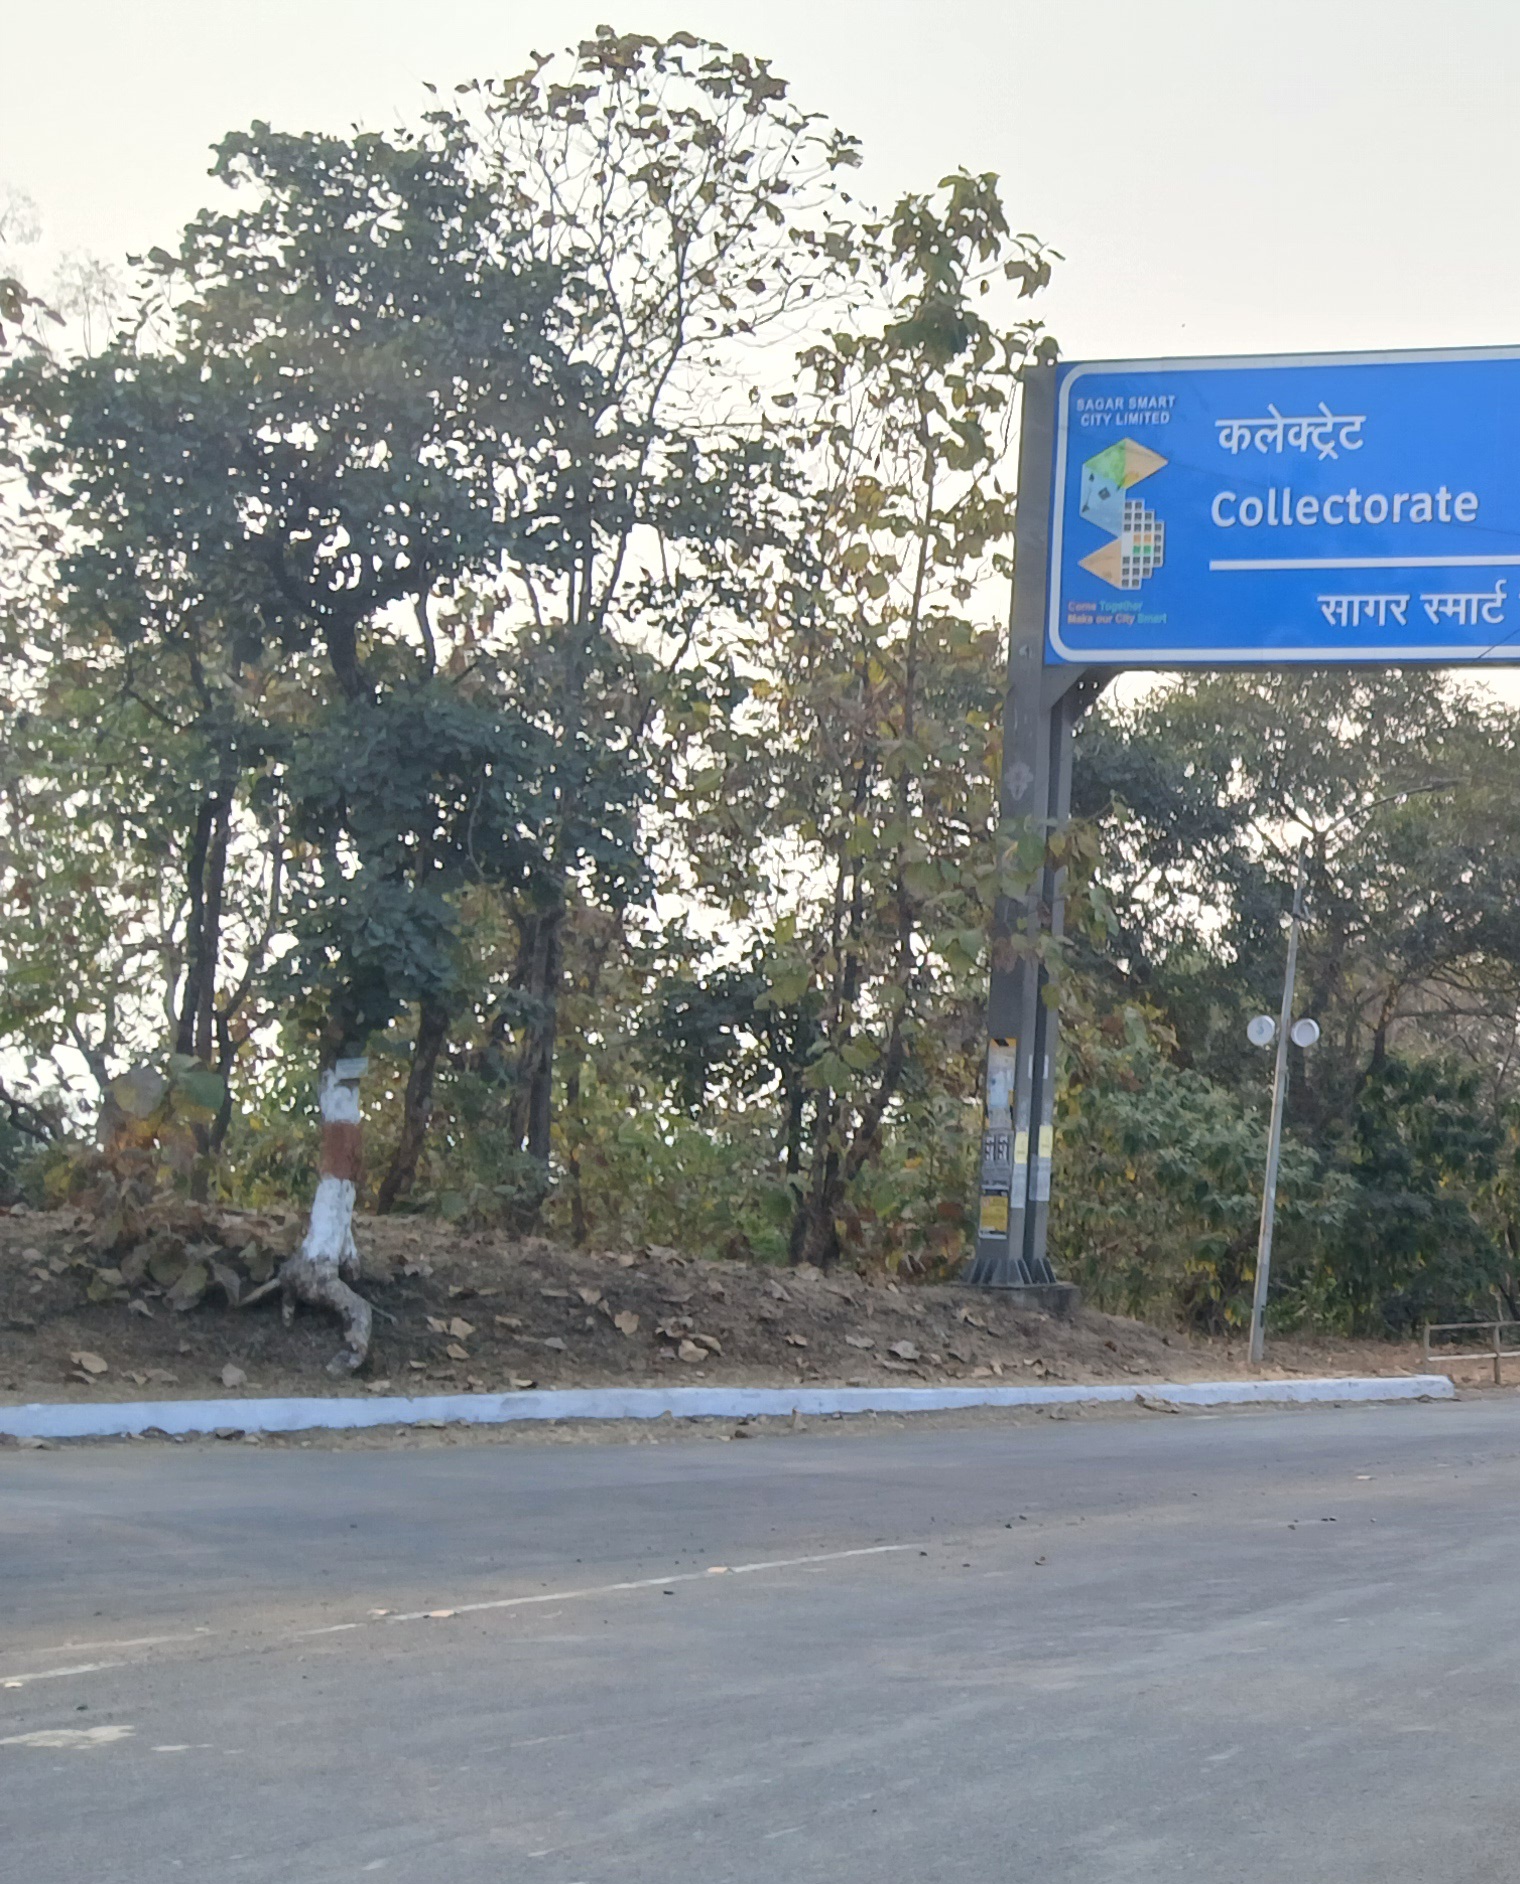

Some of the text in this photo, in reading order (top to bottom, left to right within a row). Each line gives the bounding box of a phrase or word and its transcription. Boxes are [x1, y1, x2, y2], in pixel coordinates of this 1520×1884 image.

[1076, 395, 1176, 411] SAGAR SMART
[1080, 411, 1170, 427] CITY LIMITED
[1215, 402, 1366, 460] कलेक्ट्रेट
[1211, 486, 1478, 527] Collectorate
[1317, 595, 1410, 626] सागर
[1421, 579, 1507, 625] स्मार्ट
